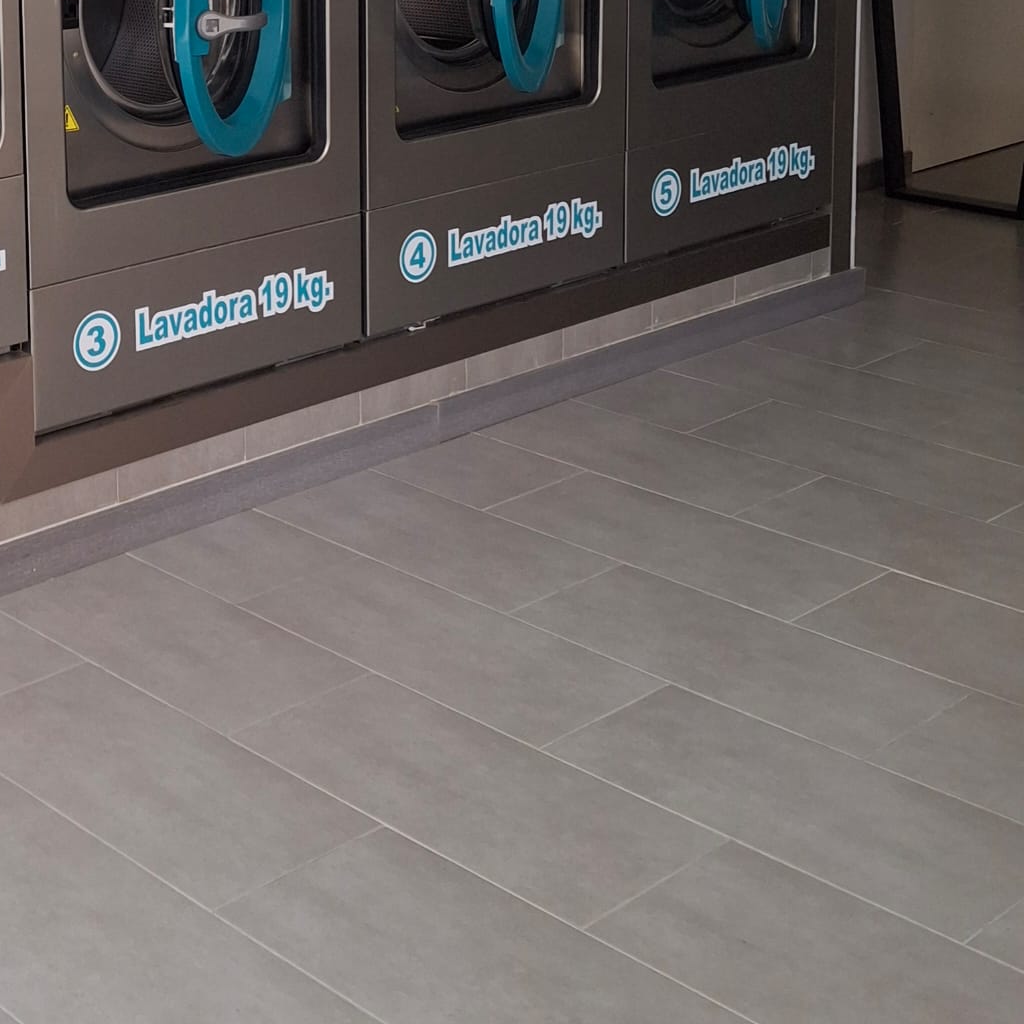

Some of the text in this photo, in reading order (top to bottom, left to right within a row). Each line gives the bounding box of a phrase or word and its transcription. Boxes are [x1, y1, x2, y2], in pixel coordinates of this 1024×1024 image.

[659, 146, 814, 206] 5 Lavadora 19 kg.
[409, 202, 601, 269] 4 Lavadora 19 kg.
[86, 272, 332, 358] 3 Lavadora 19 kg.
